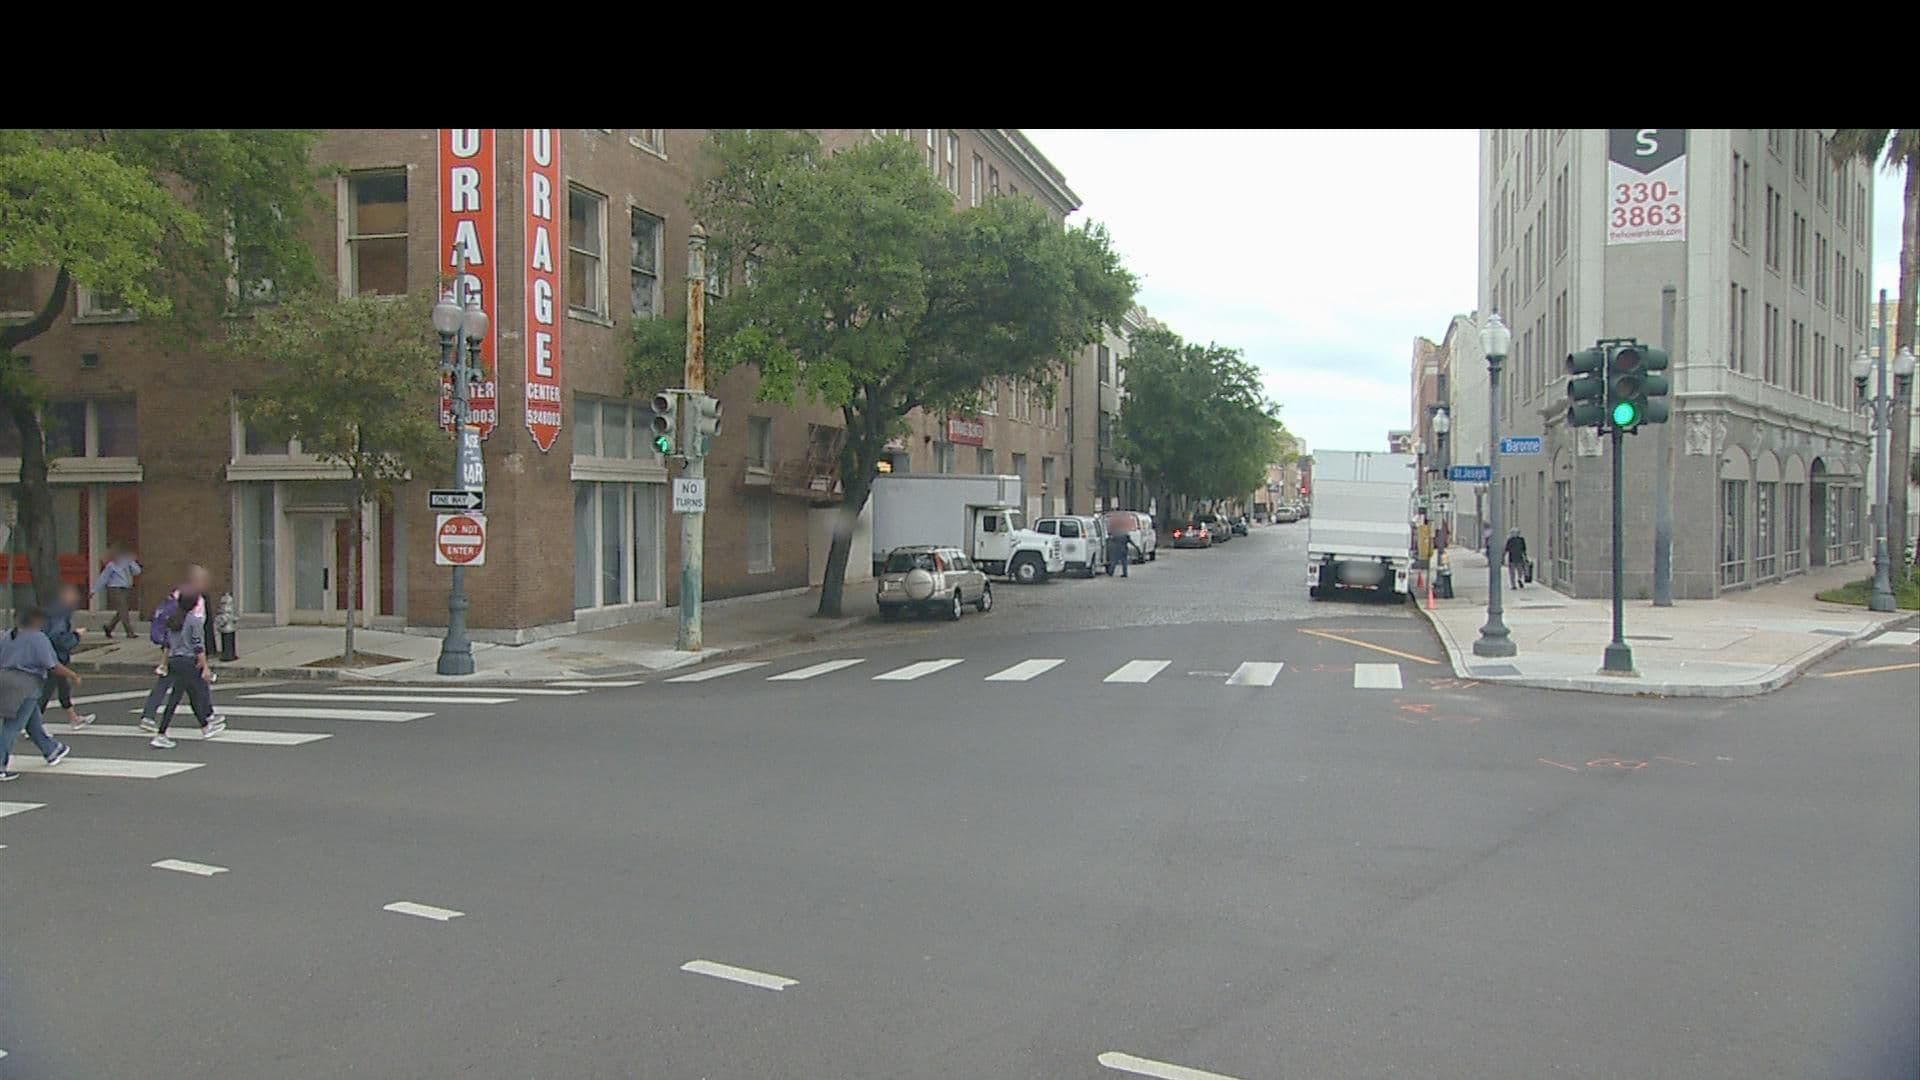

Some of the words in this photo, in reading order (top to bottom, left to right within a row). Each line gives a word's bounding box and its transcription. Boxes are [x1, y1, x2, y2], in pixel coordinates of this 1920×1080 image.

[1615, 181, 1679, 204] 330-
[1611, 203, 1682, 228] 3863
[527, 383, 560, 402] CENTER
[1505, 439, 1539, 452] Baronne
[682, 483, 697, 493] NO
[434, 496, 449, 504] ONE
[452, 496, 466, 504] WAY
[676, 497, 704, 507] TURNS
[444, 525, 457, 533] DO
[462, 525, 478, 534] NOT
[447, 546, 475, 555] ENTER
